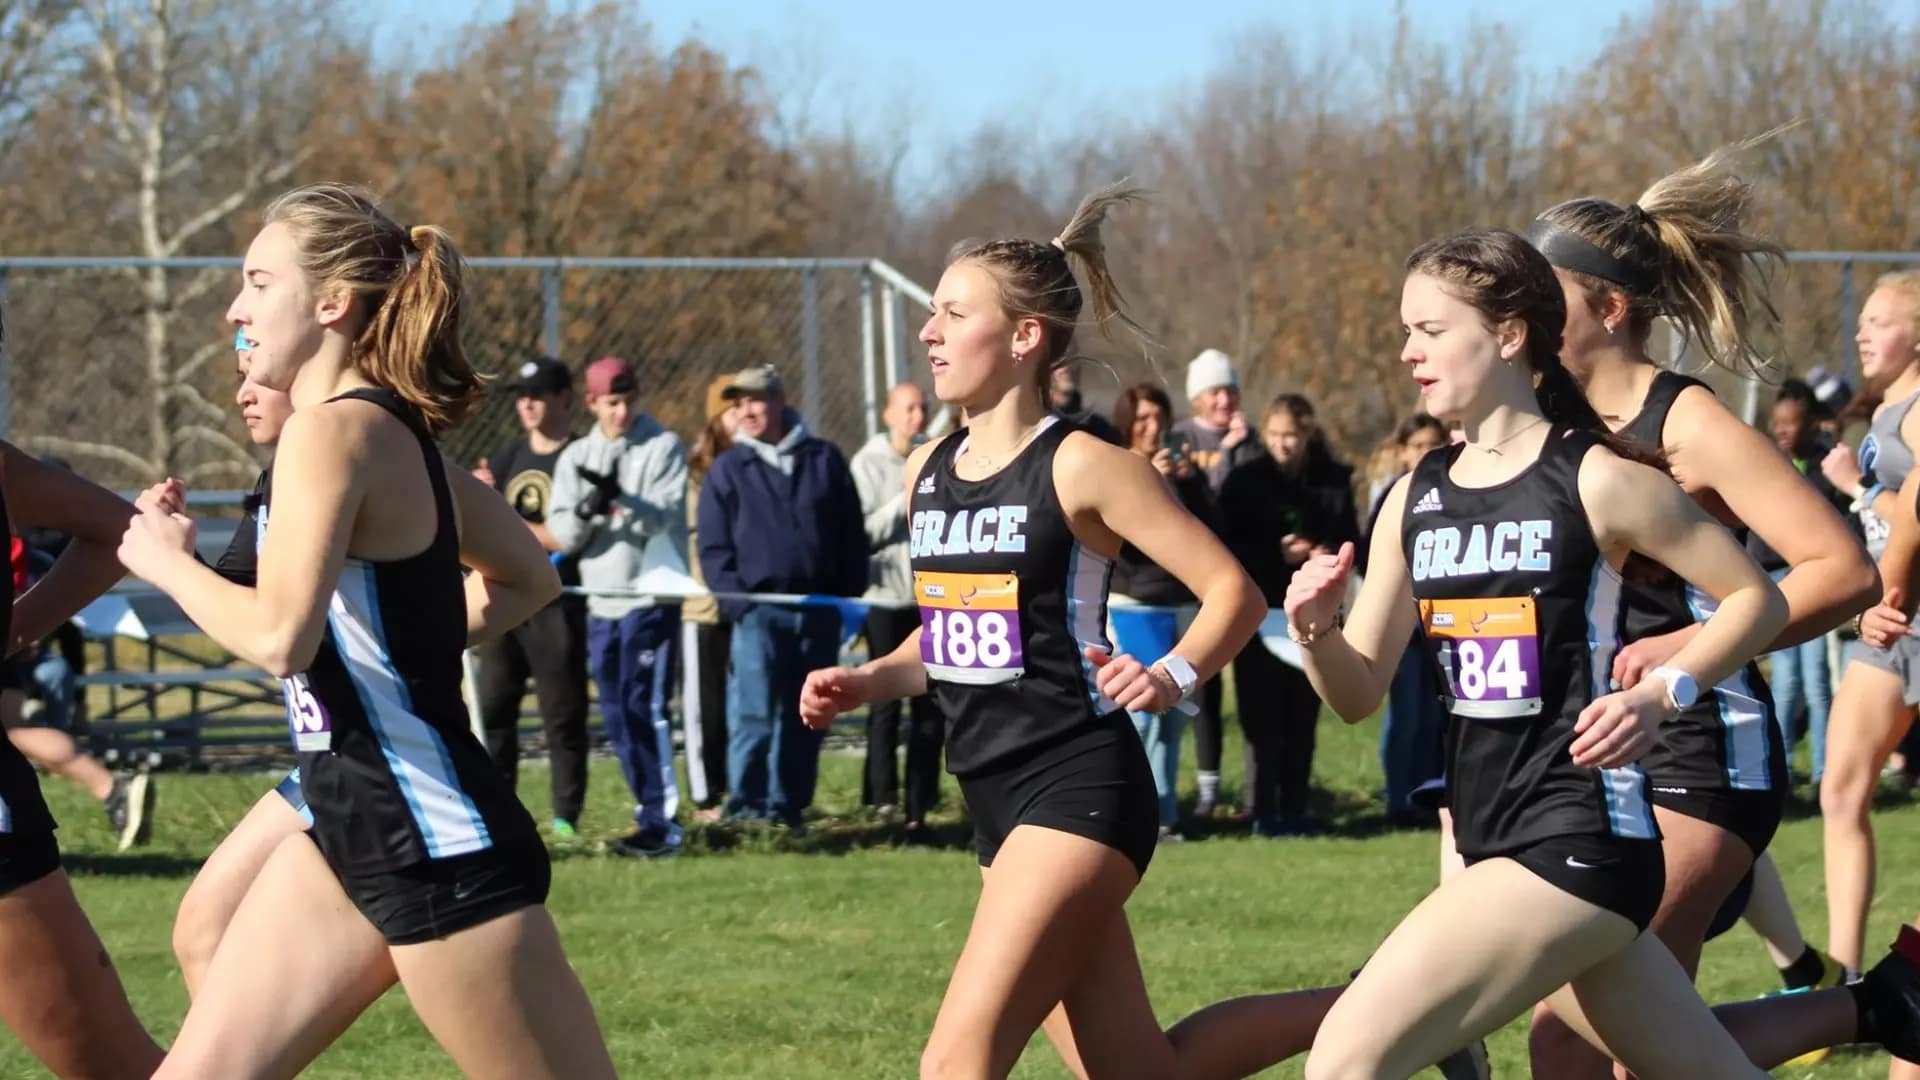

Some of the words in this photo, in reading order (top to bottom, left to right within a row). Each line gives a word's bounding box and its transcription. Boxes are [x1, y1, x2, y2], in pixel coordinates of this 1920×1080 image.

[911, 505, 1028, 559] GRACE
[1412, 520, 1552, 582] GRACE
[930, 609, 1012, 668] 188
